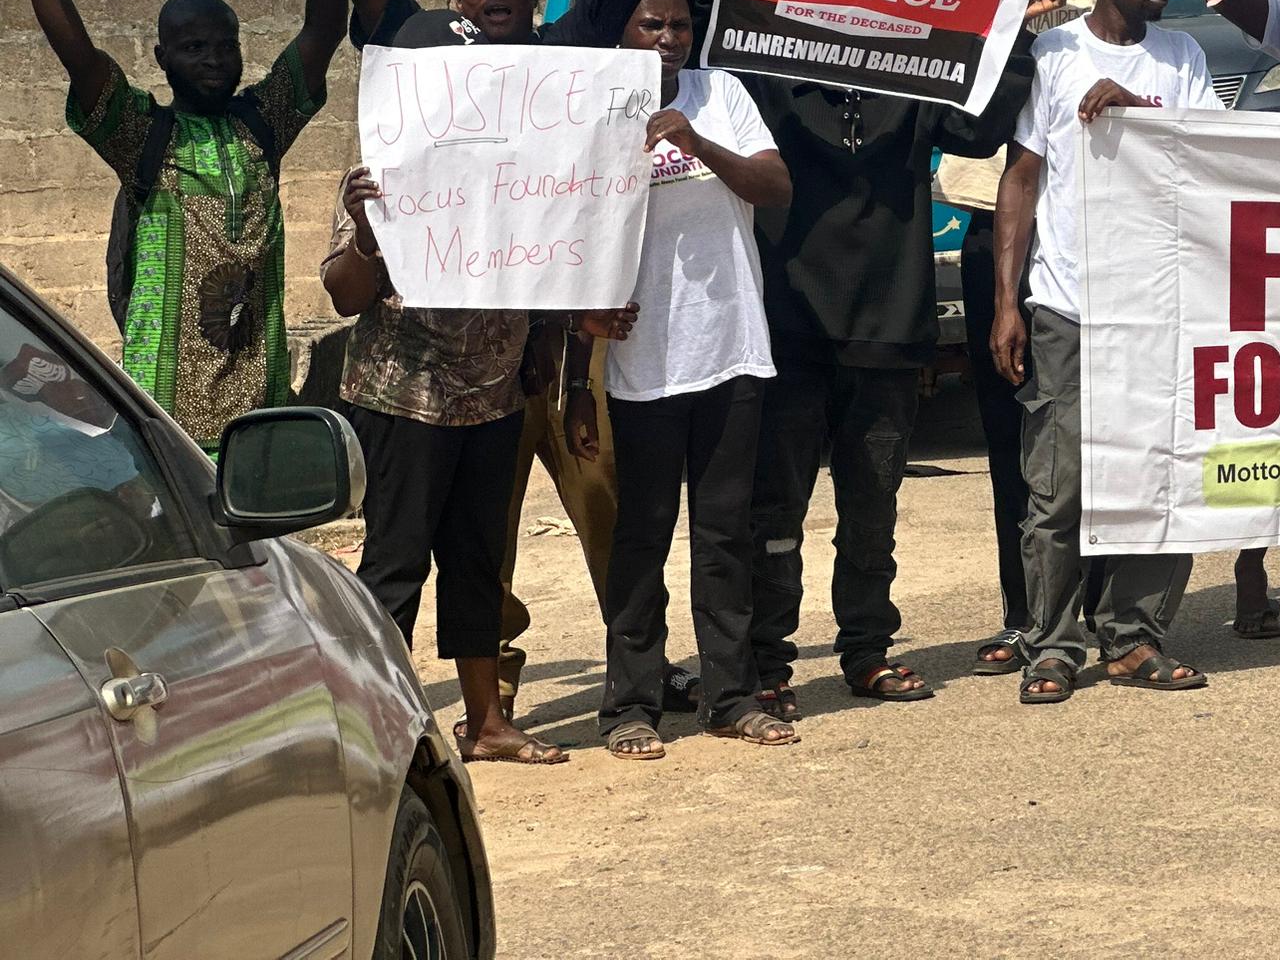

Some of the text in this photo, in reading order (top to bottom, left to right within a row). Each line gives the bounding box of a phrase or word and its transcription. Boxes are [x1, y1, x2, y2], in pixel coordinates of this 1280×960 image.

[784, 5, 922, 35] FOR THE DECEASED
[721, 27, 966, 84] OLANRENWAJU BABALOLA
[377, 61, 653, 146] JUSTICE FOR
[380, 161, 638, 222] Focus Foundation
[425, 225, 585, 282] Members
